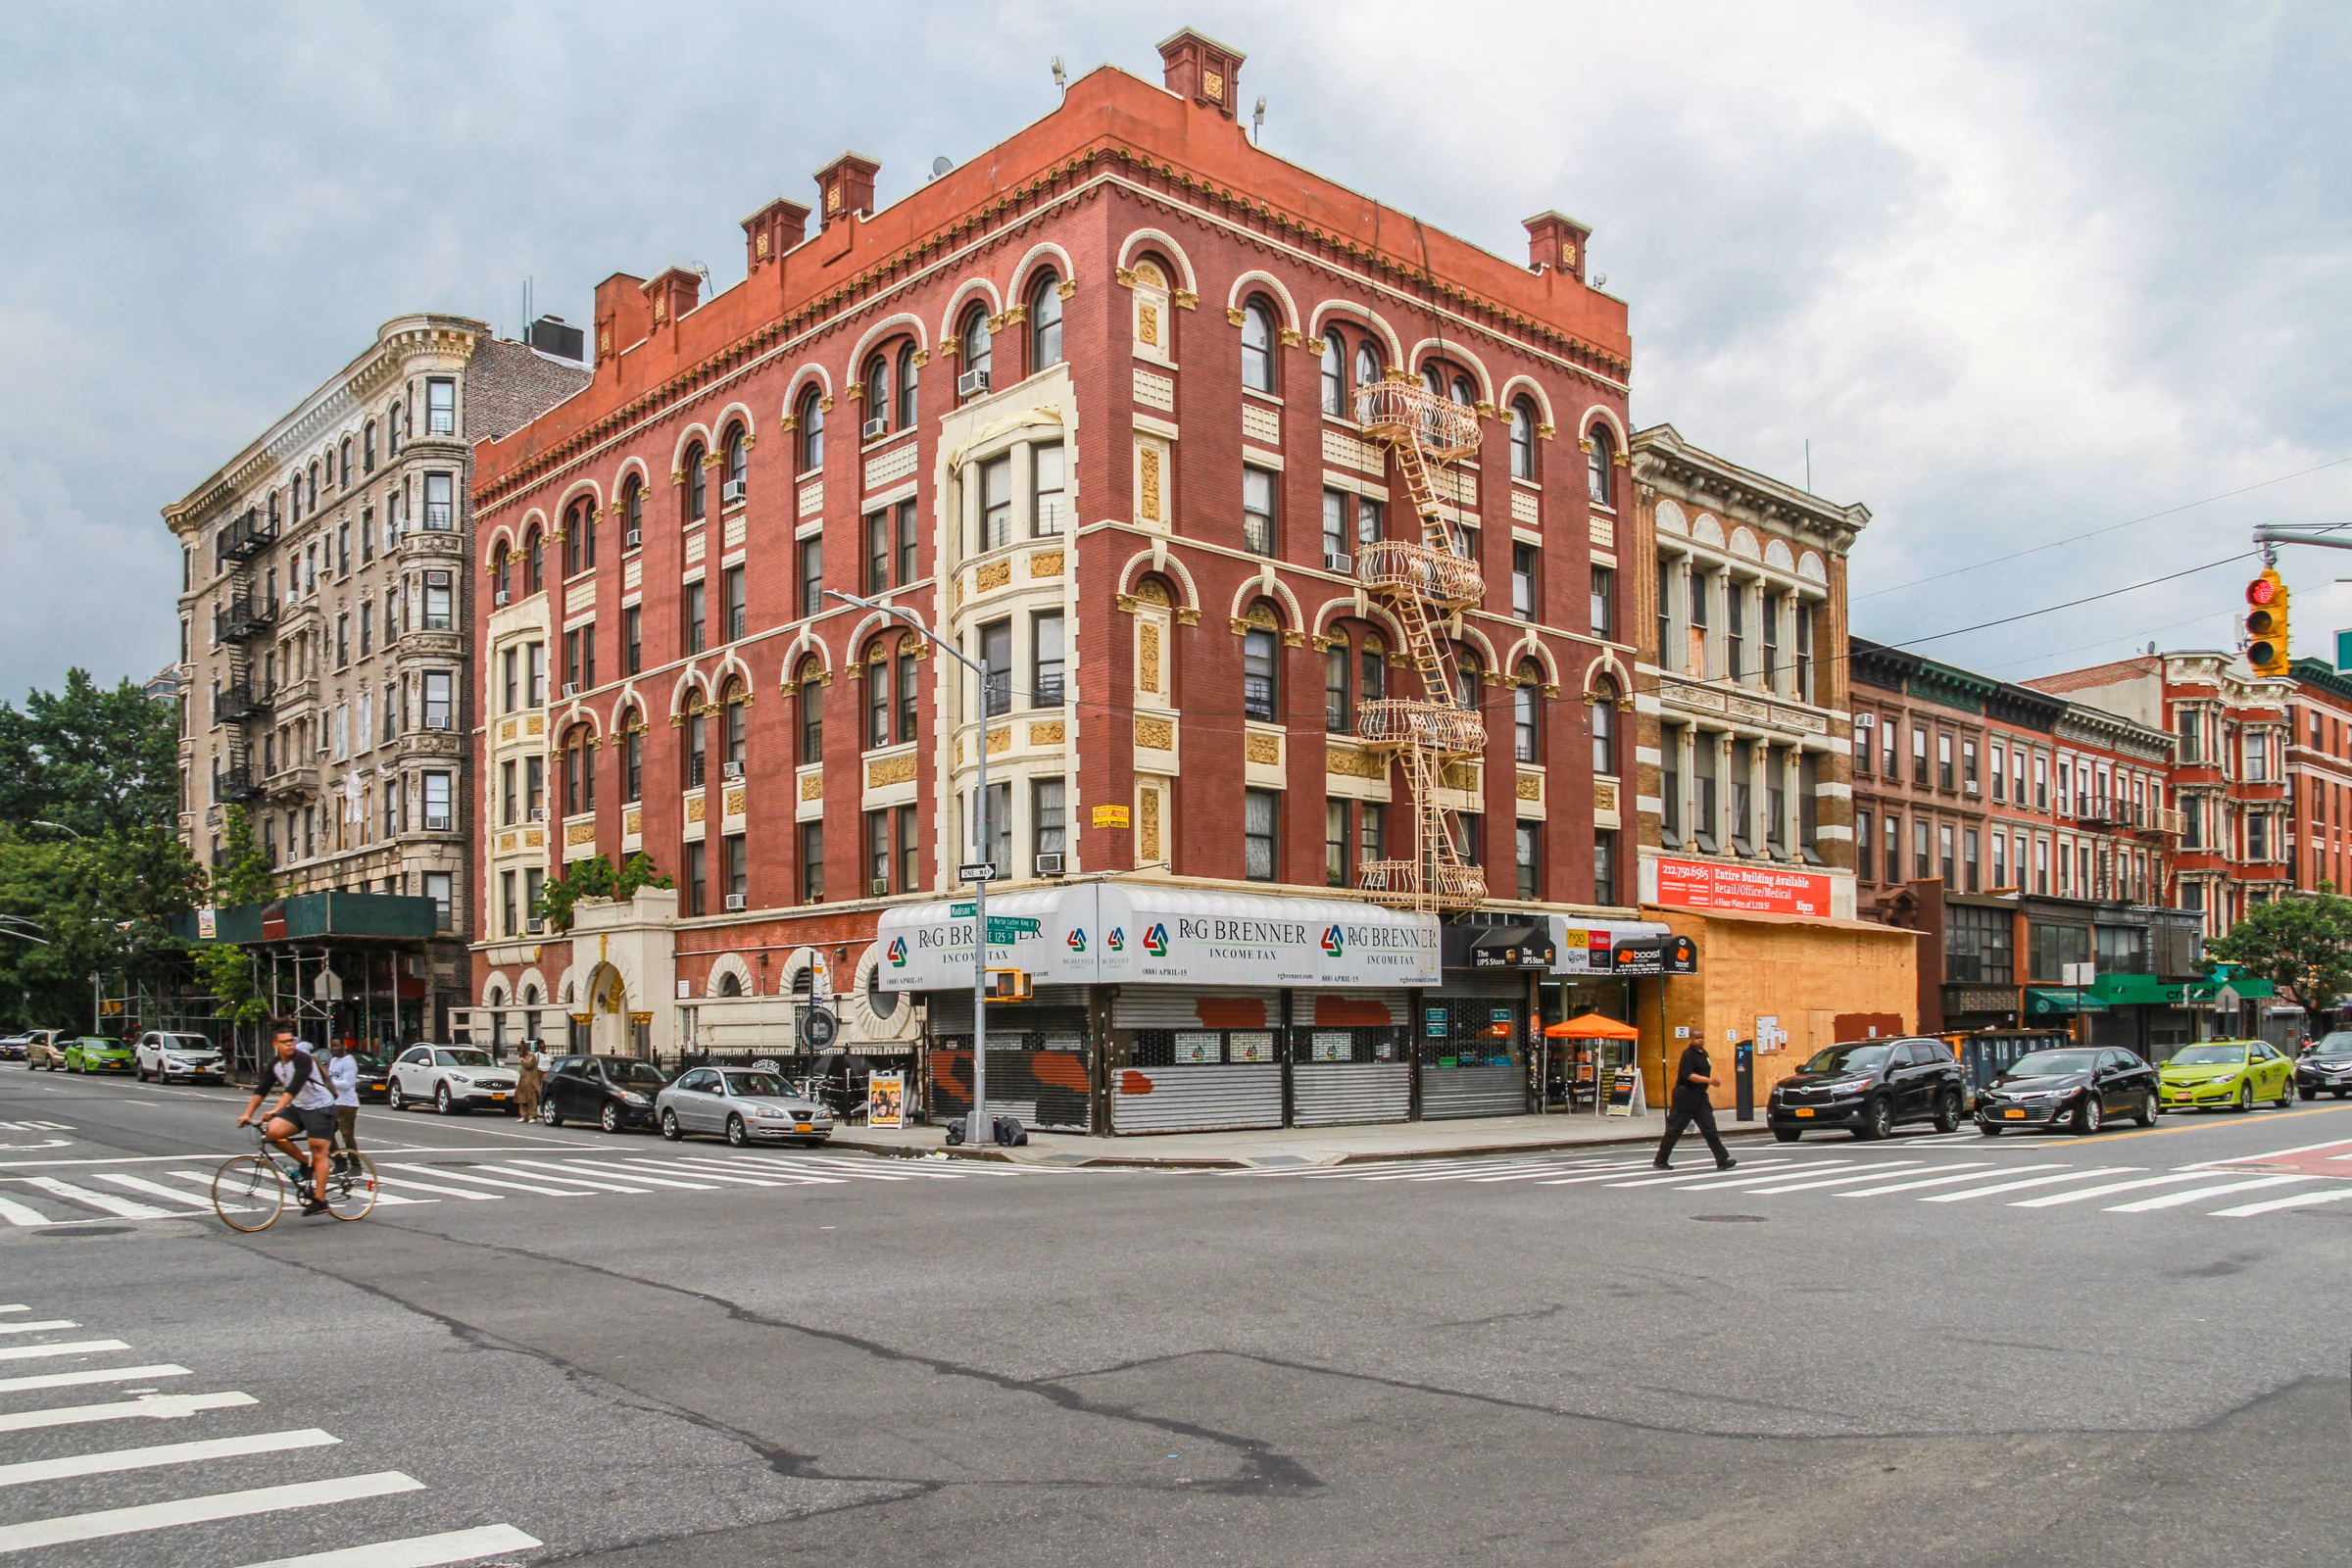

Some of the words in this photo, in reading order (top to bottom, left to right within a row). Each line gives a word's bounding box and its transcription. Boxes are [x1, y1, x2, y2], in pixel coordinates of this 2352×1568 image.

[1662, 864, 1709, 880] 212.750.6565
[1714, 868, 1740, 881] Entire
[1741, 871, 1774, 887] Building
[1775, 875, 1810, 888] Available
[1714, 882, 1791, 900] Retail/Office/Medical
[1718, 898, 1731, 906] Floor
[1731, 899, 1745, 908] Plates
[1796, 901, 1814, 913] Ripco
[951, 906, 971, 916] Madison
[1006, 917, 1020, 926] Luther
[1178, 918, 1208, 940] R&G
[1214, 920, 1307, 945] BRENNER
[918, 927, 944, 949] R&G
[988, 931, 993, 942] E
[995, 931, 1006, 943] 125
[1348, 926, 1368, 947] R&G
[1371, 927, 1438, 949] BRENNER
[1209, 948, 1254, 960] INCOME
[1257, 950, 1277, 960] TAX
[1522, 947, 1533, 956] The
[1633, 949, 1660, 959] boost
[943, 952, 977, 964] INCOM
[988, 950, 1008, 960] TAX
[1071, 956, 1095, 965] BRENNER
[1367, 955, 1398, 965] INCOME
[1400, 956, 1415, 965] TAX
[1476, 957, 1490, 966] UPS
[1157, 968, 1188, 977] APRIL-15
[1277, 972, 1313, 981] rgbrenner.com
[899, 976, 924, 985] APRIL-15
[1334, 974, 1360, 983] APRIL-15
[1739, 1051, 1744, 1059] P
